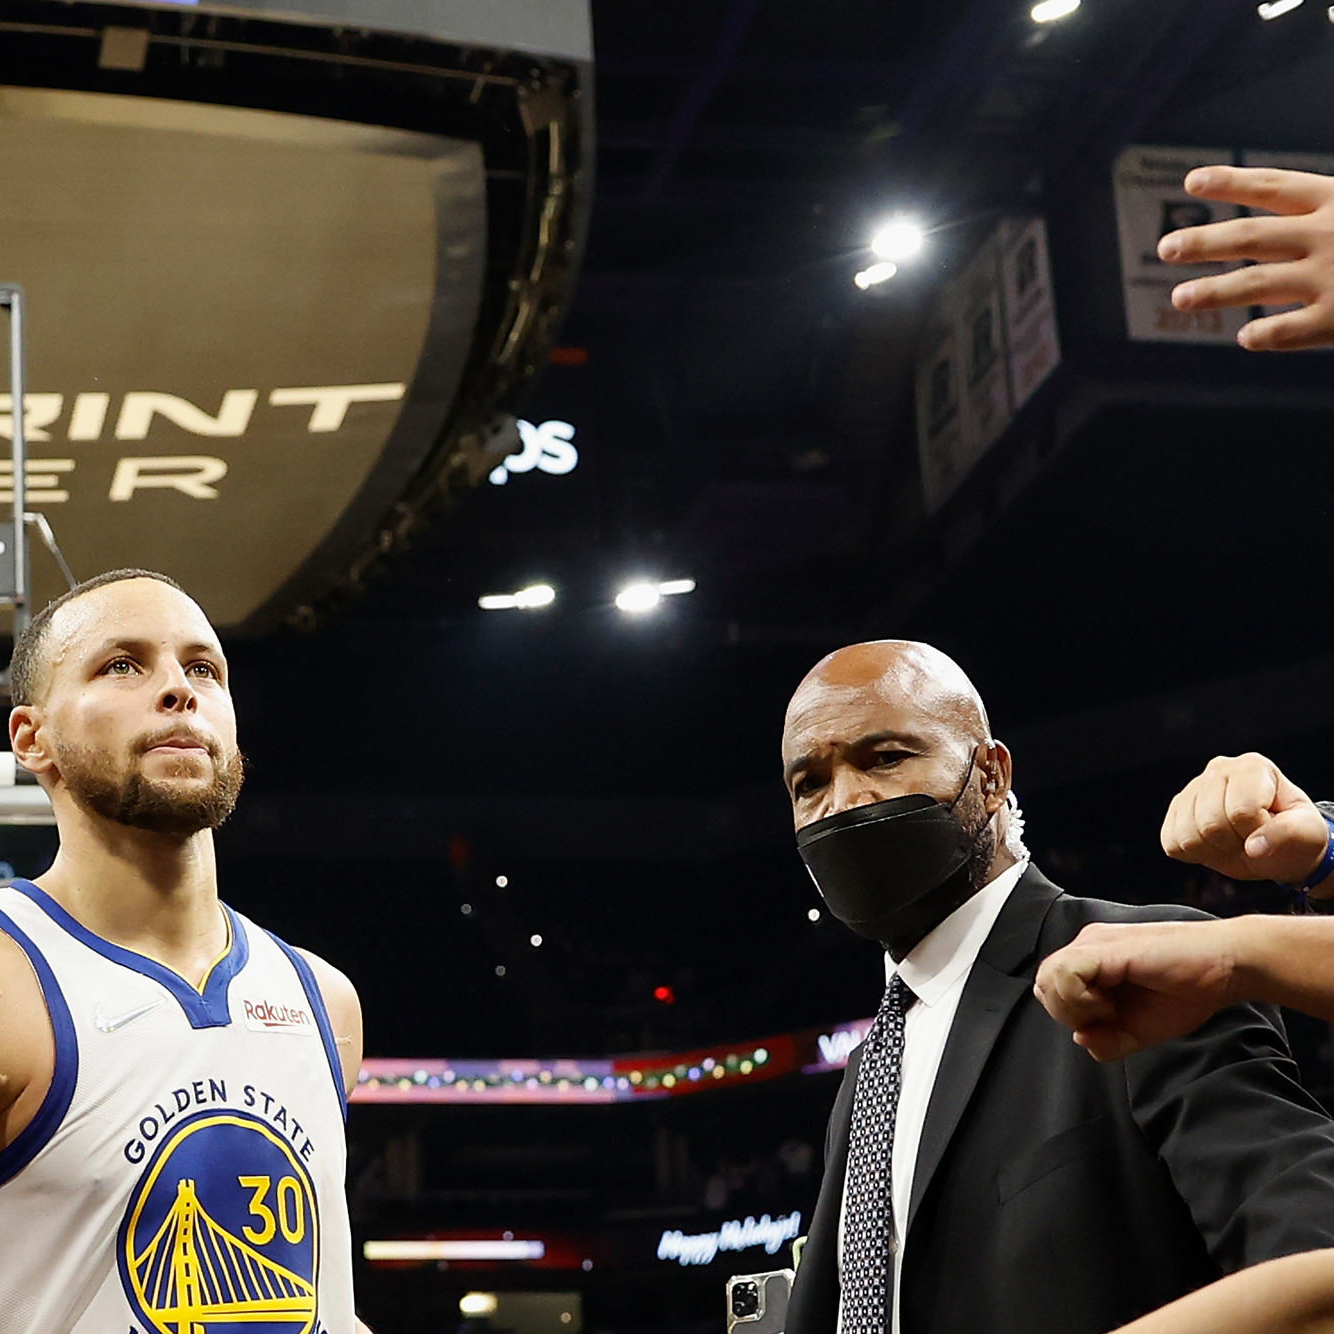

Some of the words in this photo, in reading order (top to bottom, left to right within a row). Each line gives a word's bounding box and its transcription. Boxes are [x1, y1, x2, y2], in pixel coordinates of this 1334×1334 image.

[244, 1000, 311, 1025] Rakuten
[124, 1078, 228, 1165] GOLDEN
[243, 1084, 315, 1162] STATE
[238, 1175, 305, 1245] 30
